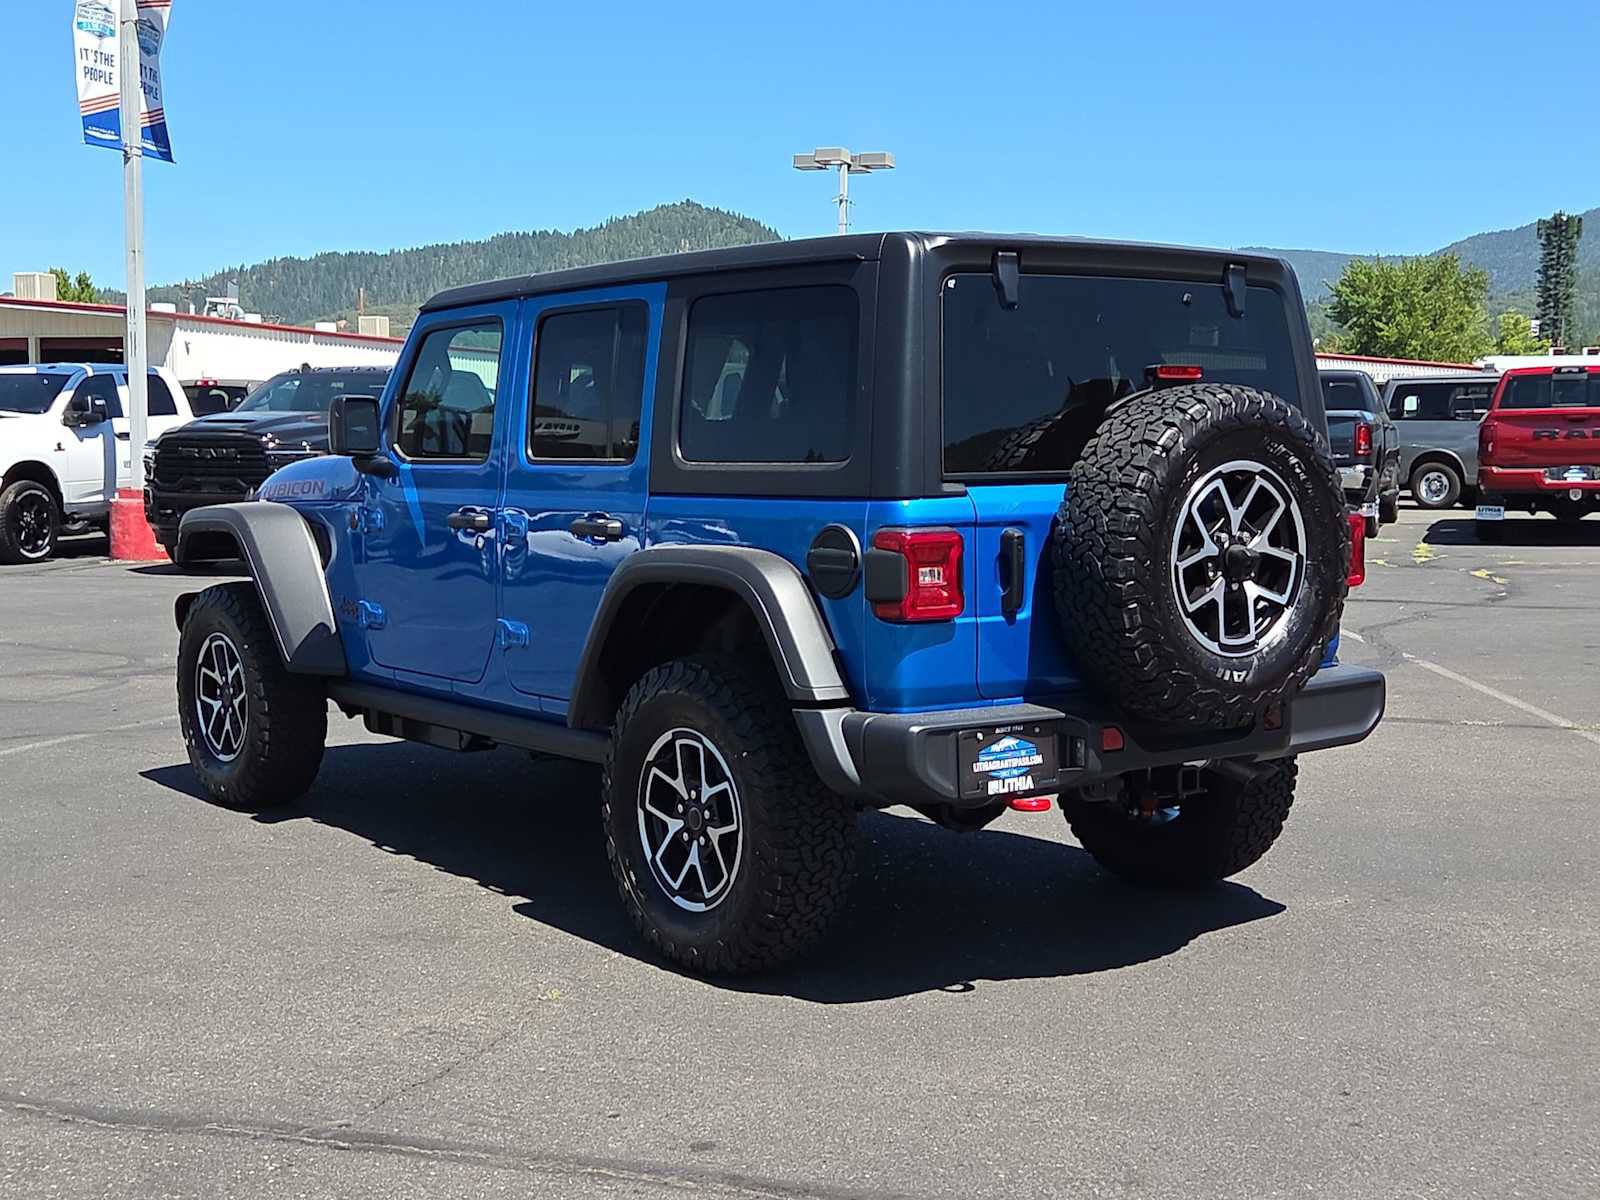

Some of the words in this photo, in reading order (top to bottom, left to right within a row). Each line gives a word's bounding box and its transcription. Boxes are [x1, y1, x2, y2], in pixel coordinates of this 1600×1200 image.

[79, 47, 99, 64] IT'S
[99, 51, 115, 68] THE
[83, 66, 114, 85] PEOPLE
